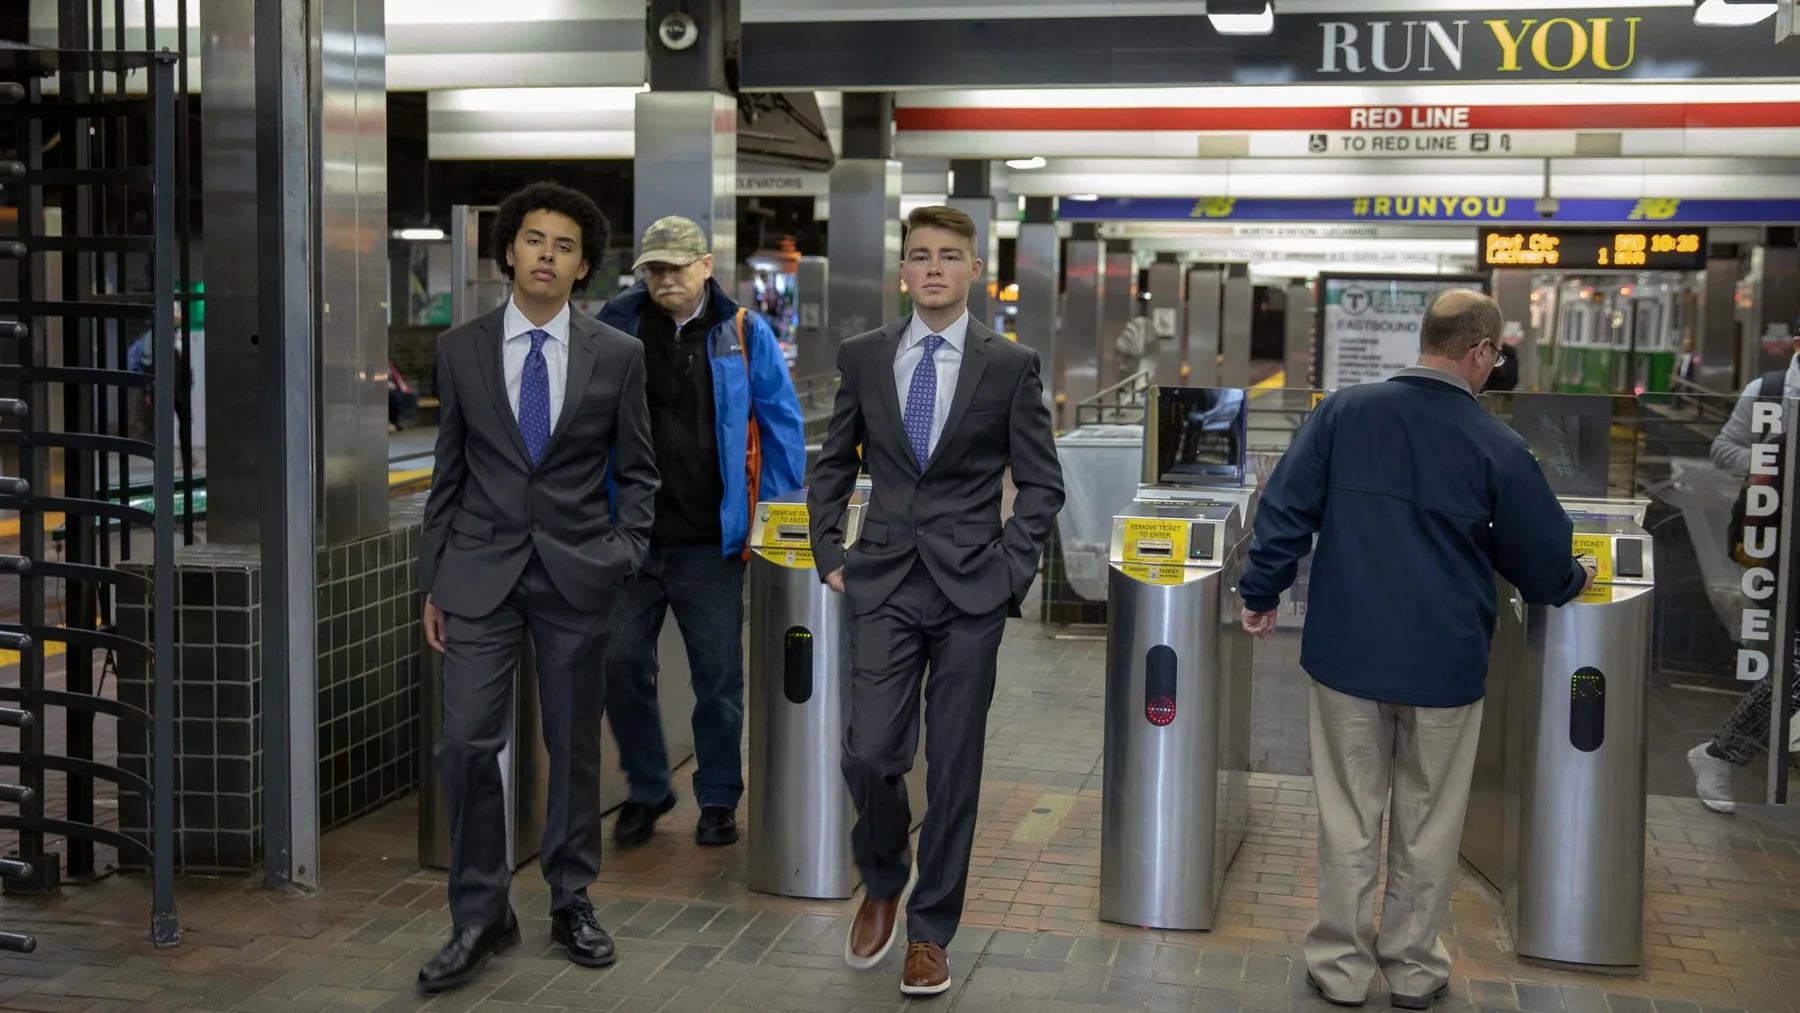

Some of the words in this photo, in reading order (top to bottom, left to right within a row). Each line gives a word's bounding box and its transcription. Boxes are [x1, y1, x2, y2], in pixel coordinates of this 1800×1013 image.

[1316, 20, 1470, 73] RUN
[1483, 17, 1643, 72] YOU
[1350, 107, 1404, 129] RED
[1411, 106, 1471, 129] LINE
[1341, 136, 1366, 151] TO
[1371, 136, 1410, 151] RED
[1415, 135, 1458, 151] LINE
[1352, 196, 1507, 217] #RUNYOU
[1597, 247, 1609, 265] 1
[772, 509, 797, 517] REMOVE
[1130, 523, 1158, 532] REMOVE
[1159, 524, 1182, 533] TICKET
[1150, 531, 1172, 539] ENTER
[1580, 540, 1605, 548] TICKET
[1736, 401, 1784, 680] REDUCED
